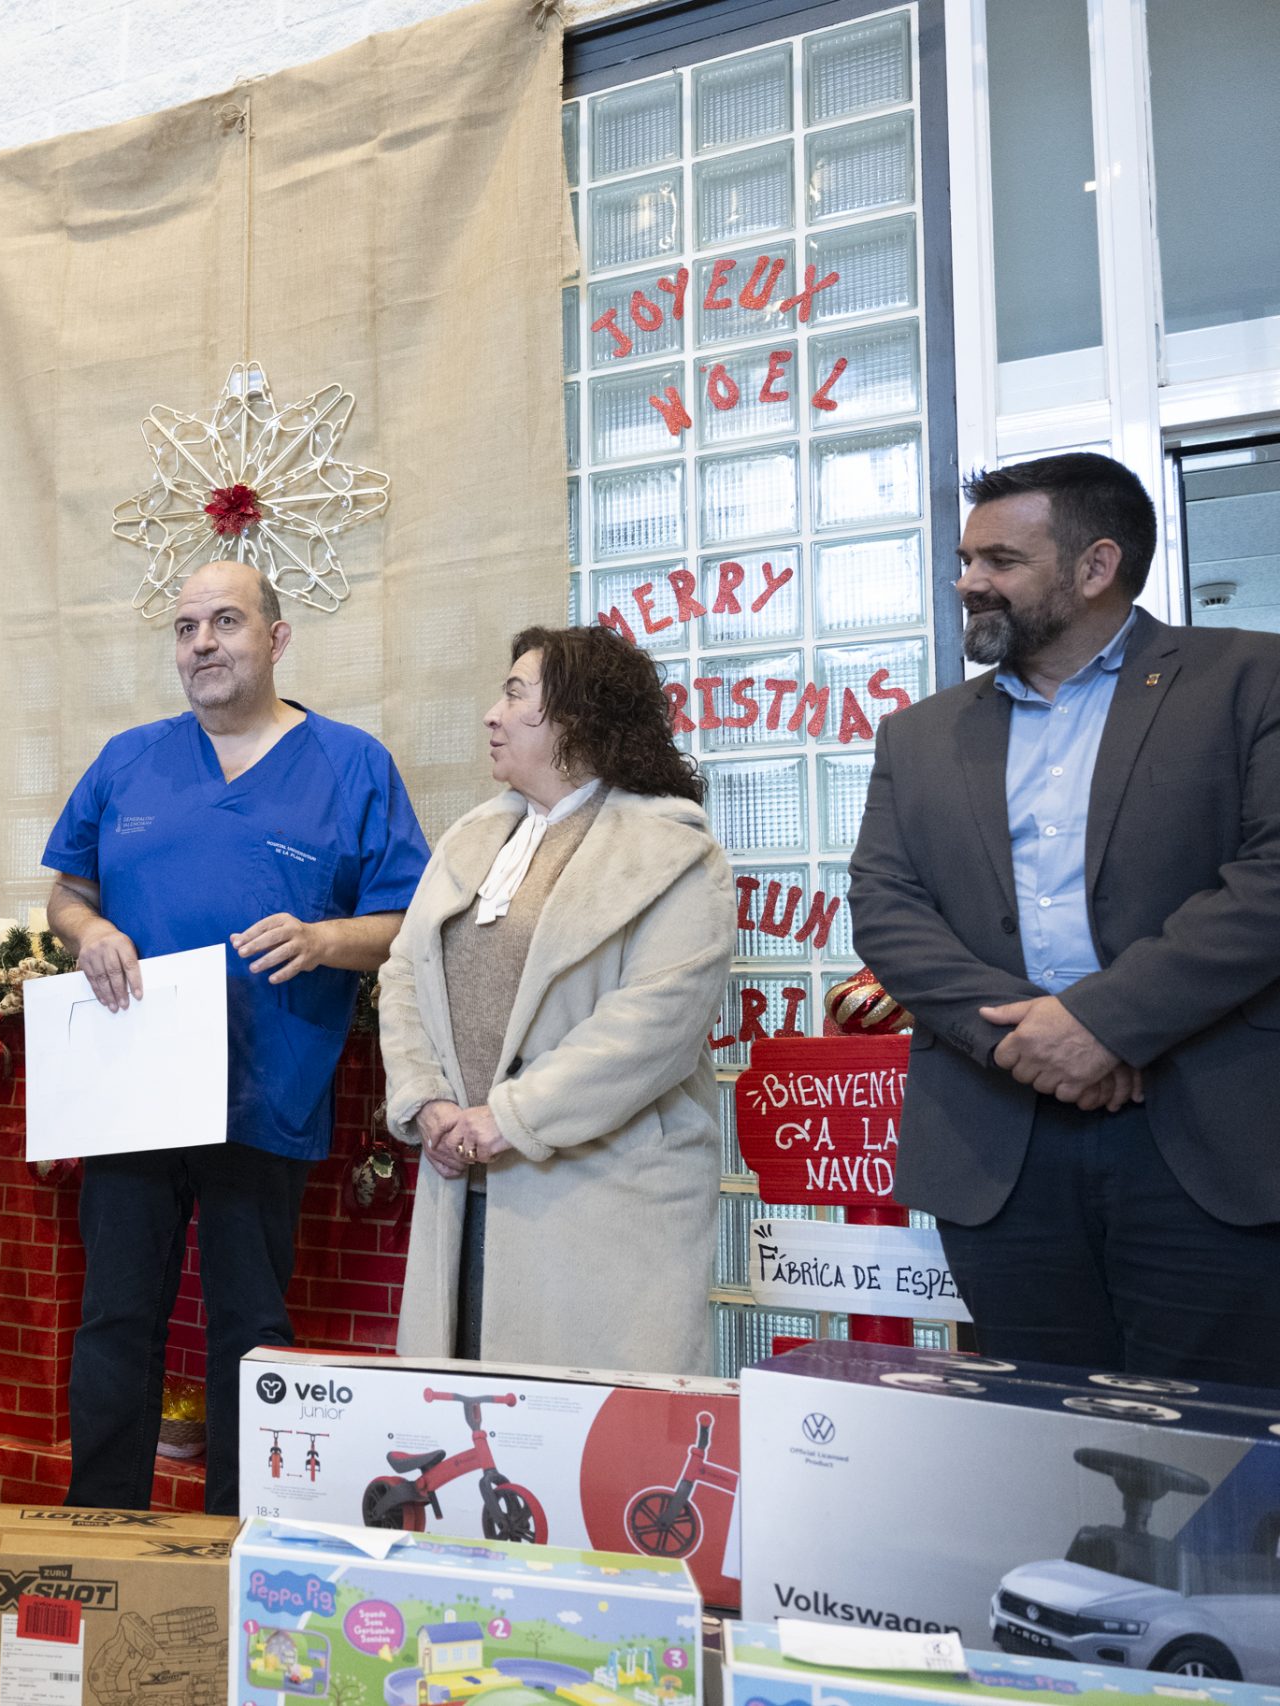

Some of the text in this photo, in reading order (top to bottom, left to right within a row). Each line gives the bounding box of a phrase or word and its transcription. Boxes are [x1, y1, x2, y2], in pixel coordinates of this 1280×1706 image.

[591, 256, 839, 357] JOYEUX
[649, 351, 847, 436] NOEL
[598, 562, 793, 645] MERRY
[668, 669, 912, 744] RISTMAS
[813, 1117, 899, 1151] A LA
[806, 1152, 896, 1197] NAVID
[853, 1263, 882, 1291] DE
[896, 1267, 963, 1299] ESPE
[294, 1379, 354, 1404] velo
[298, 1402, 346, 1421] junior
[44, 1568, 68, 1579] ZURU
[250, 1570, 334, 1612] Peppa Pig
[773, 1582, 962, 1634] Volkswagen
[492, 1619, 508, 1639] 2
[1008, 1625, 1049, 1647] T-ROC
[668, 1649, 683, 1669] 3
